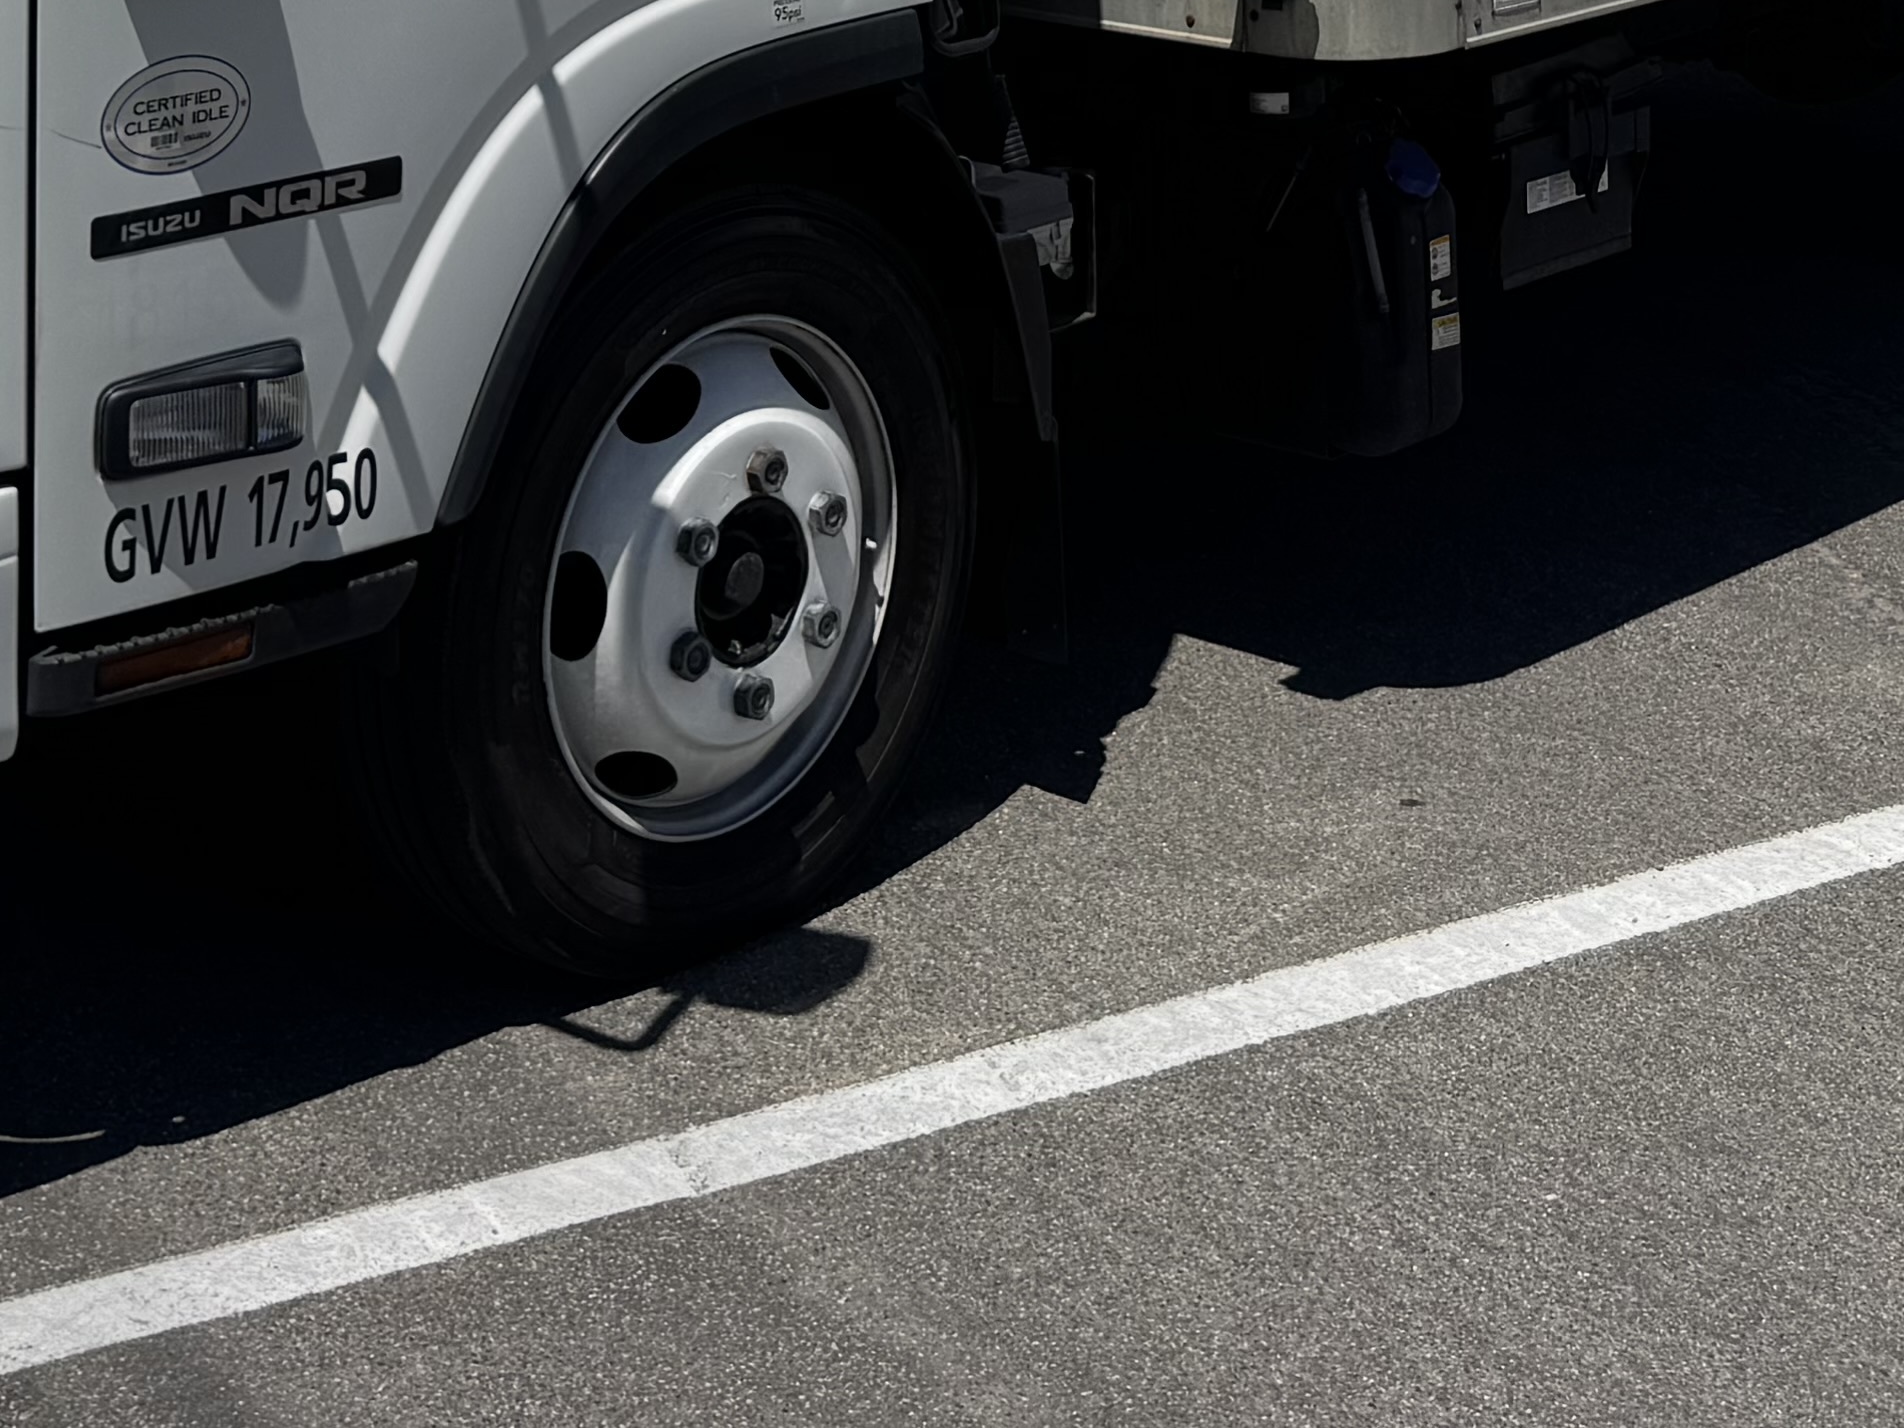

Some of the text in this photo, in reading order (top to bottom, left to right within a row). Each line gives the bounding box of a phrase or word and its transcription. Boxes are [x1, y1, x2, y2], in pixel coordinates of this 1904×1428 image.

[124, 105, 230, 137] CLEAN IDLE
[132, 88, 223, 116] CERTIFIED
[120, 169, 367, 243] ISUZU NQR
[104, 447, 378, 584] GVW 17,950
